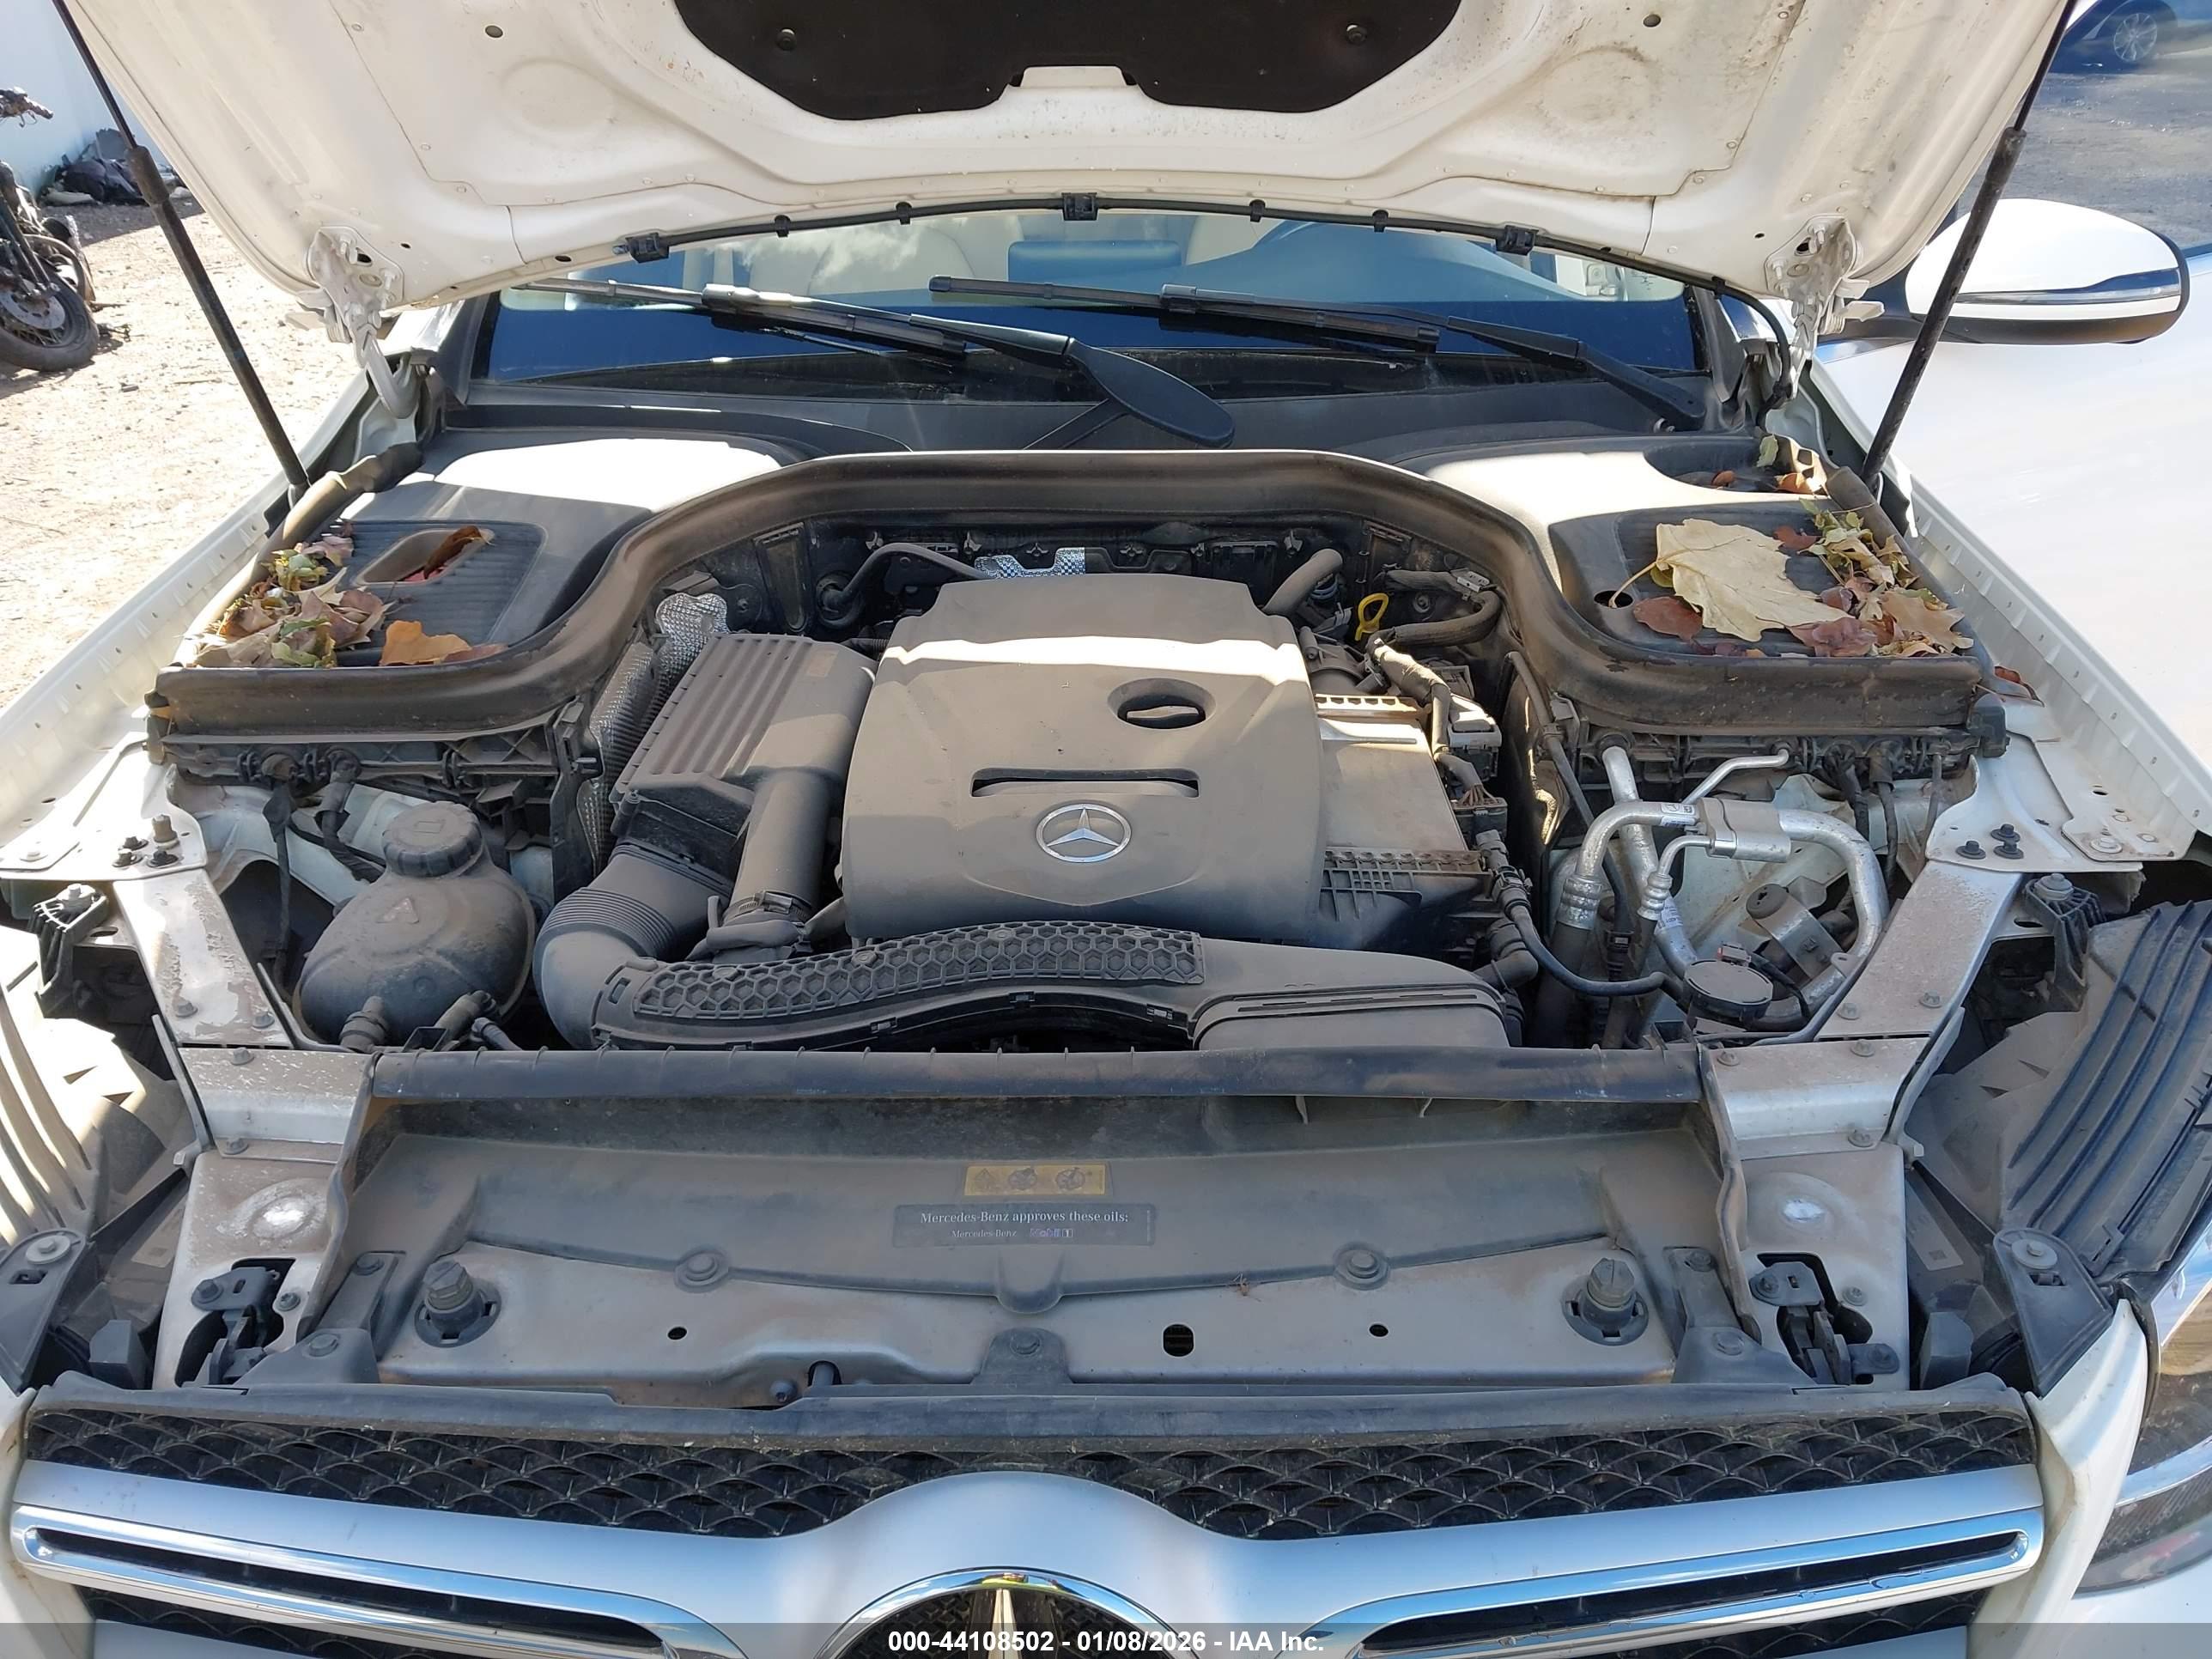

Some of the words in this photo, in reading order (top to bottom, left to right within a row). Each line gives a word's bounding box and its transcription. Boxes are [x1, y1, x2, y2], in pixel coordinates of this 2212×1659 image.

[921, 1211, 1010, 1223] Mercedes-Benz
[1012, 1211, 1066, 1224] approves
[1069, 1210, 1101, 1222] these
[1103, 1211, 1129, 1223] oils:
[951, 1229, 1017, 1237] Mercedes-Benz
